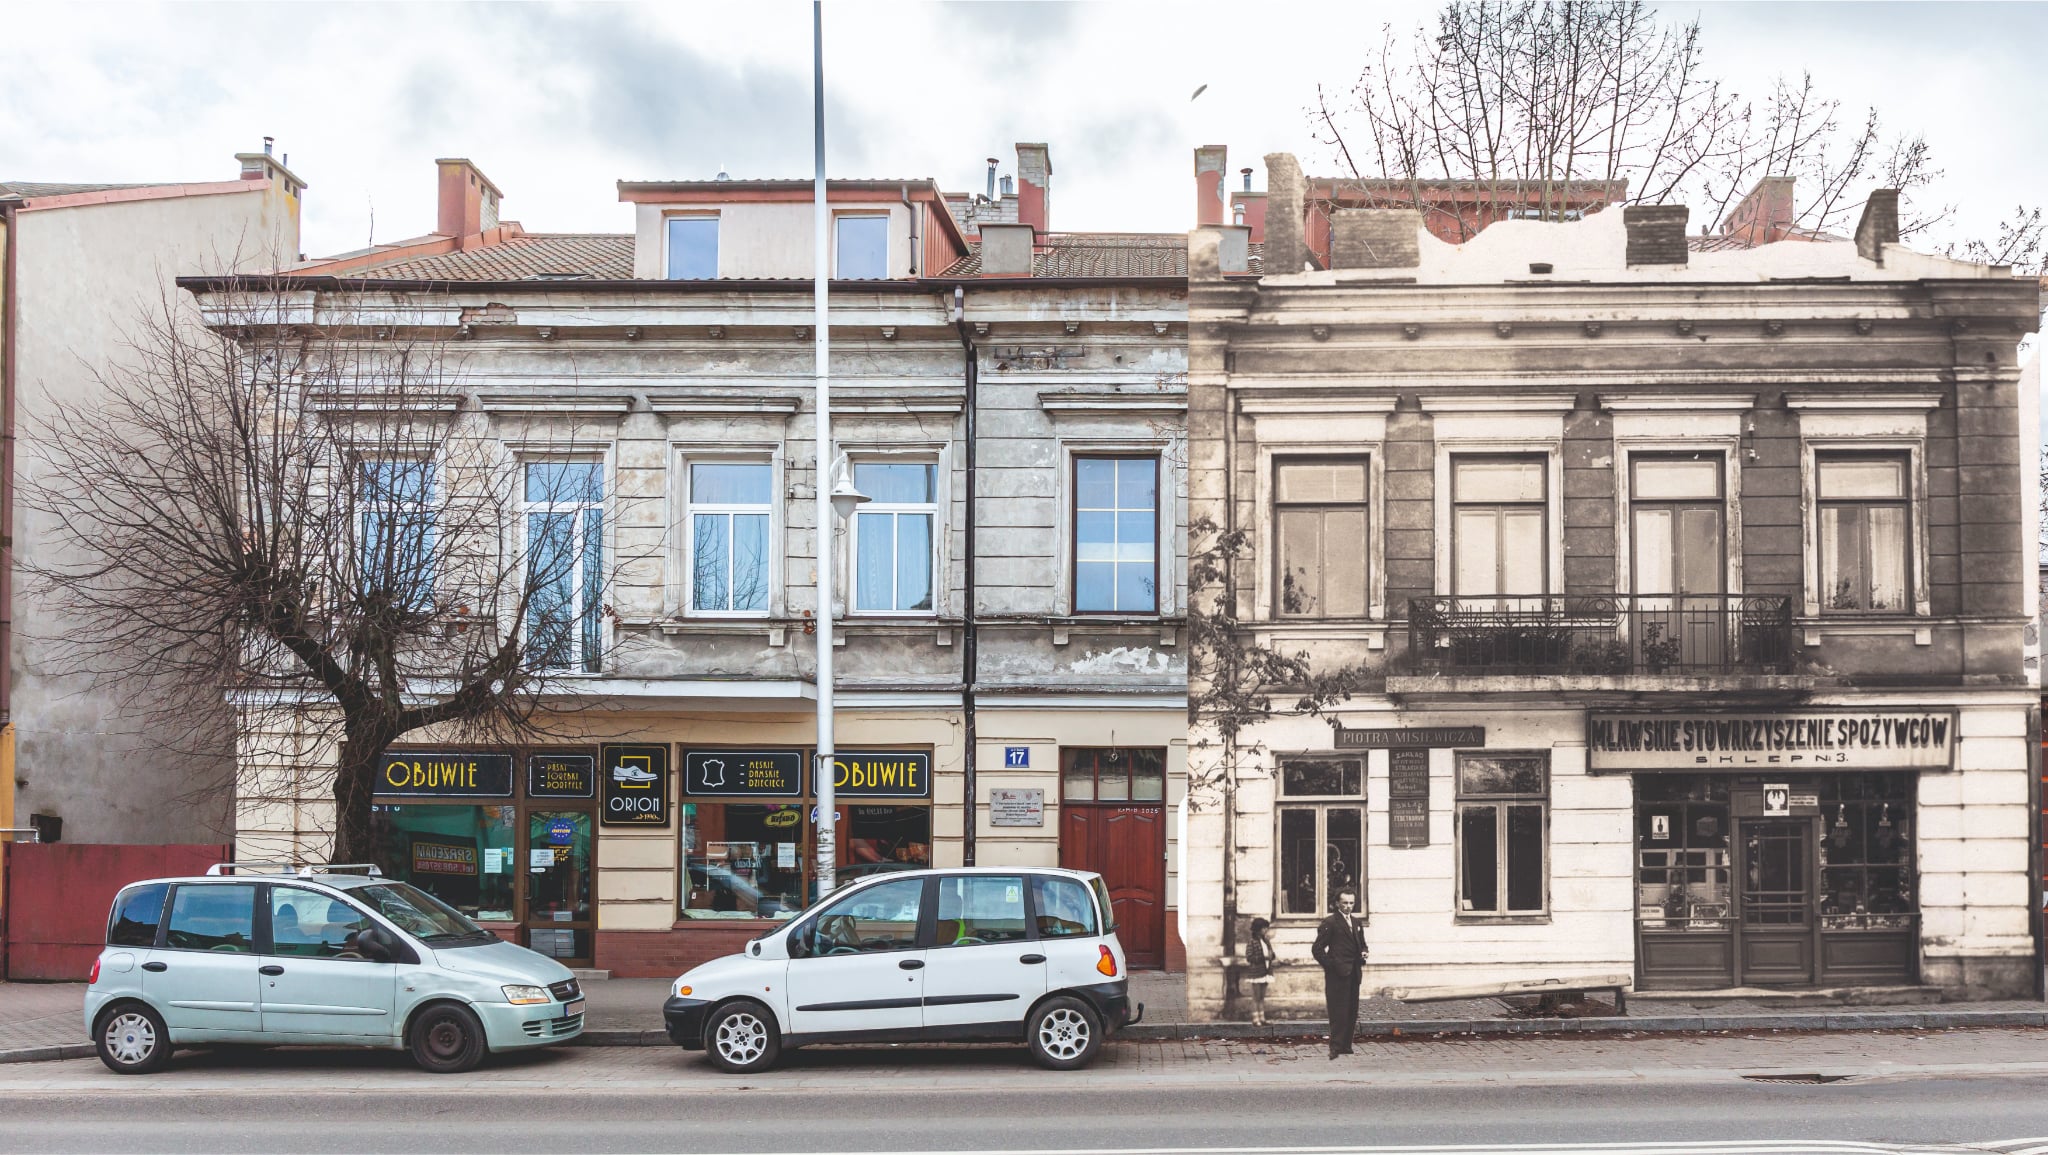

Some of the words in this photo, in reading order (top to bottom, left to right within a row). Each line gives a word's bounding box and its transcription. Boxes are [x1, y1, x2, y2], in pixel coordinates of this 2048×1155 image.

[1343, 731, 1390, 744] PIOTRA
[1591, 720, 1681, 751] MŁAWSKIE
[1683, 719, 1834, 751] STOWARZYSZENIE
[1009, 751, 1025, 765] 17
[1695, 755, 1803, 763] SKLEP
[749, 761, 774, 770] MĘSKIE
[386, 761, 478, 787] OBUWIE
[748, 770, 780, 778] DAMSKIE
[833, 761, 917, 787] OBUWIE
[610, 797, 659, 811] ORION
